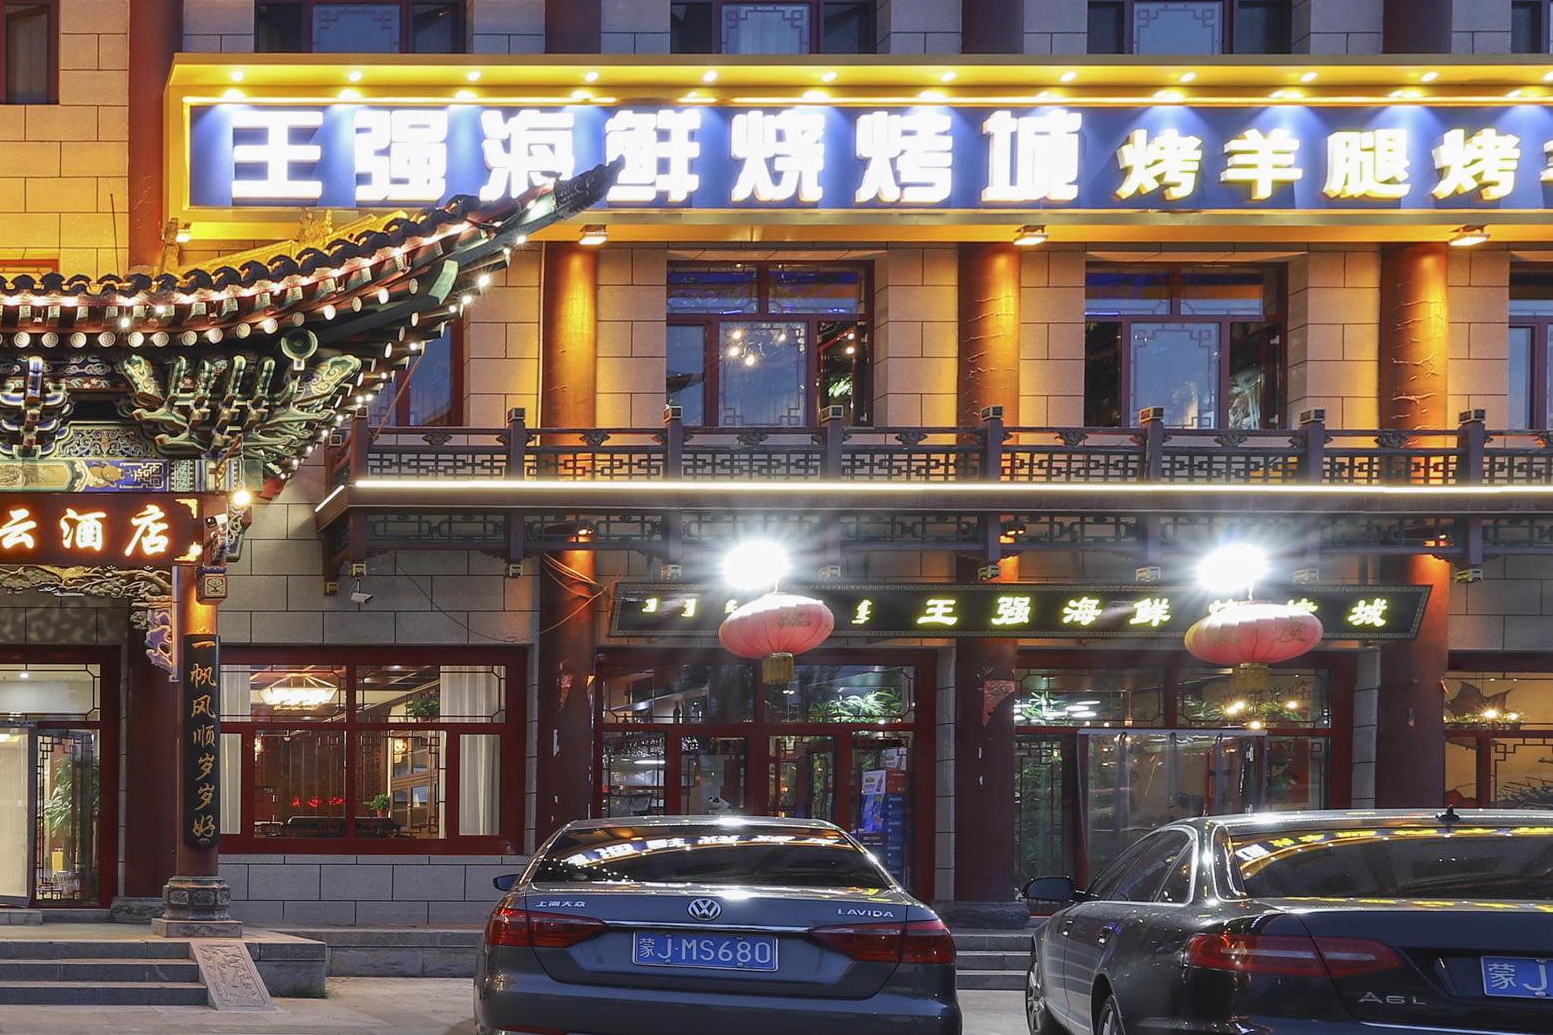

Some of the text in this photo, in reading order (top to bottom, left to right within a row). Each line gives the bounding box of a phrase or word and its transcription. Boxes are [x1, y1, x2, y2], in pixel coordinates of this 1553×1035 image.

[230, 108, 1553, 204] 王强海鲜烧烤城 烤羊腿烤
[916, 595, 1389, 629] 王强海鲜城
[190, 639, 218, 838] 一帆风顺岁岁好
[535, 899, 587, 909] 上海大众
[836, 907, 895, 919] LAVIDA
[1487, 963, 1548, 992] 蒙J
